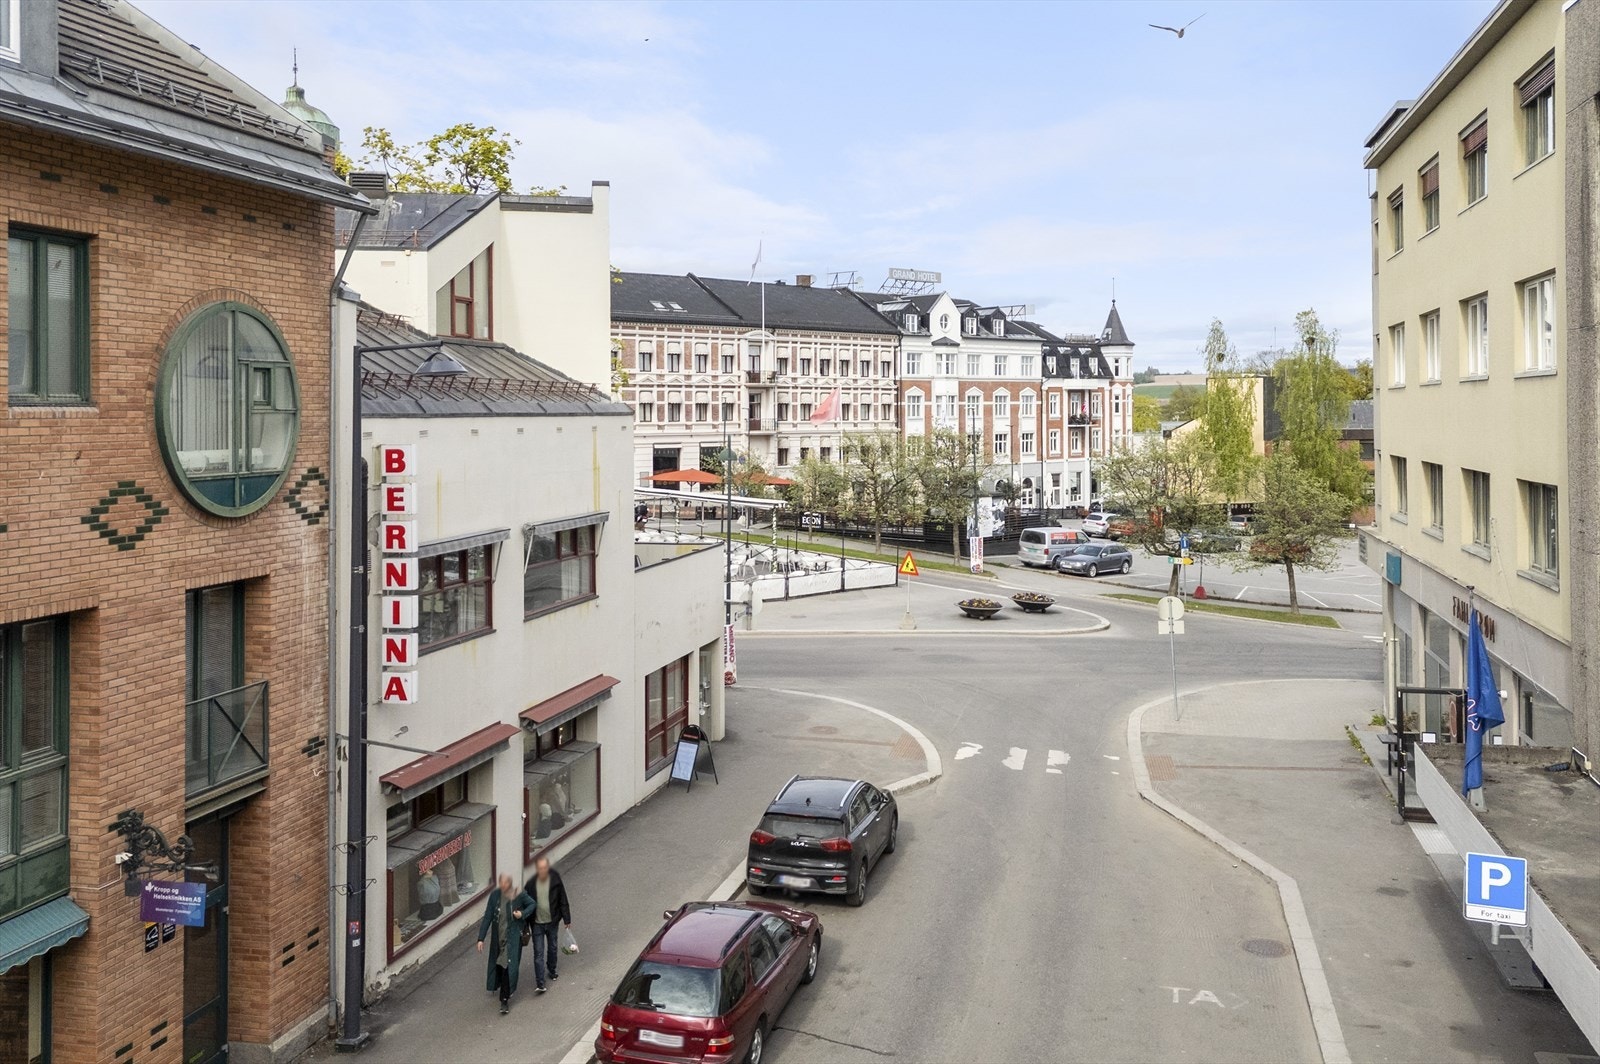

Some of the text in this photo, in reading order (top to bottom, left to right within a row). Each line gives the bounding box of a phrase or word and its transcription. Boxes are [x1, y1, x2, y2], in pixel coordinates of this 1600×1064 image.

[892, 269, 938, 282] GRAND HOTEL
[384, 448, 408, 701] BERNINA
[1481, 861, 1512, 900] P
[153, 886, 170, 894] Kropp
[153, 894, 193, 902] Helseklinikken
